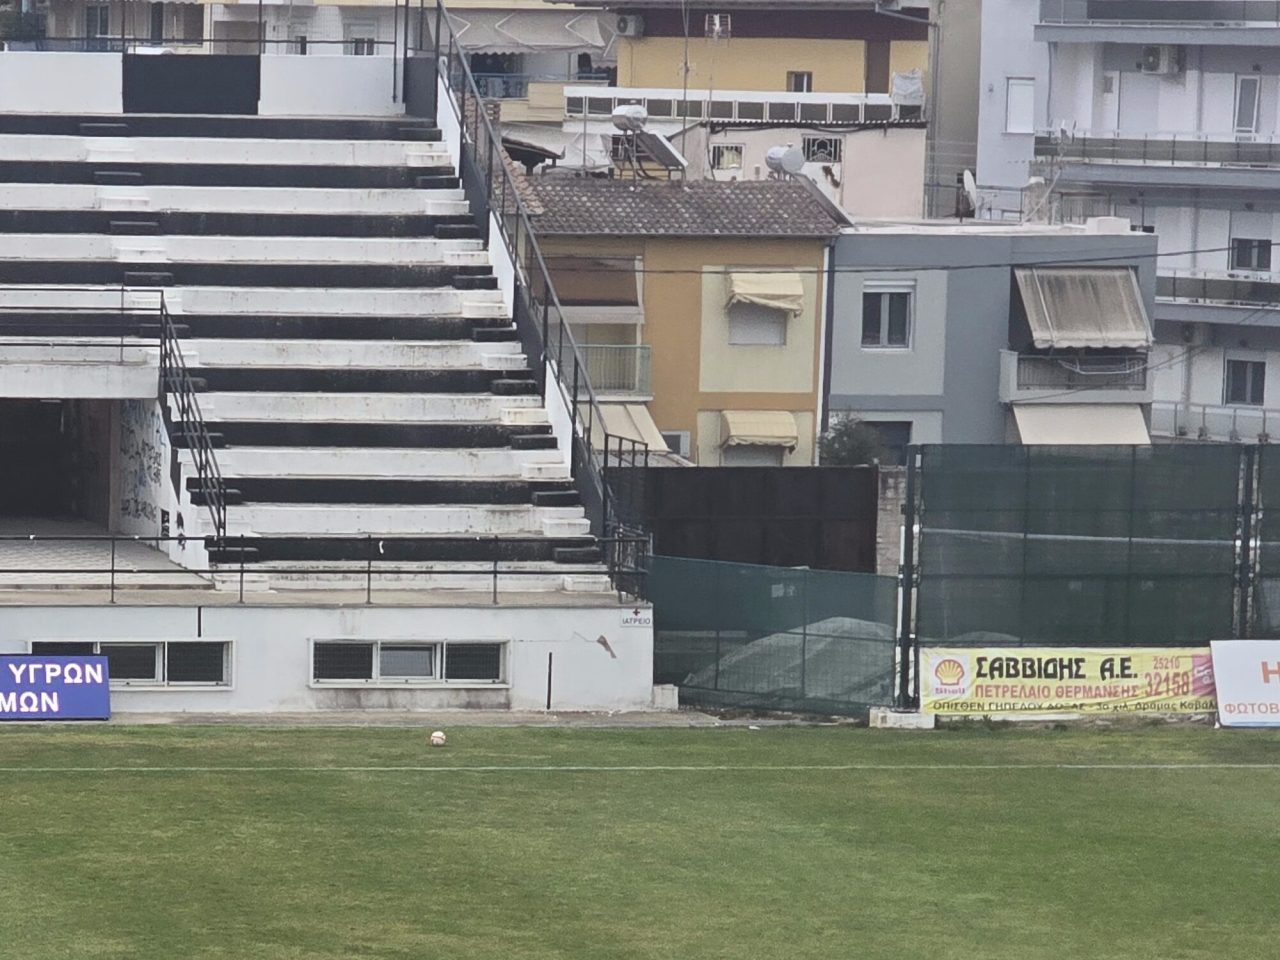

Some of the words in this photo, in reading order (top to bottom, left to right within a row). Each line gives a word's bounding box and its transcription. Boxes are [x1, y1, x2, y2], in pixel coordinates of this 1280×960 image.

[8, 663, 103, 684] ΥΓΡΩΝ
[975, 656, 1086, 681] ΣΑΒΒΙΔΗΣ
[1100, 656, 1138, 681] Α.Ε.
[975, 684, 1051, 699] ΠΕΤΡΕΛΑΙΟ
[1055, 684, 1140, 699] ΘΕΡΜΑΝΣΗΣ
